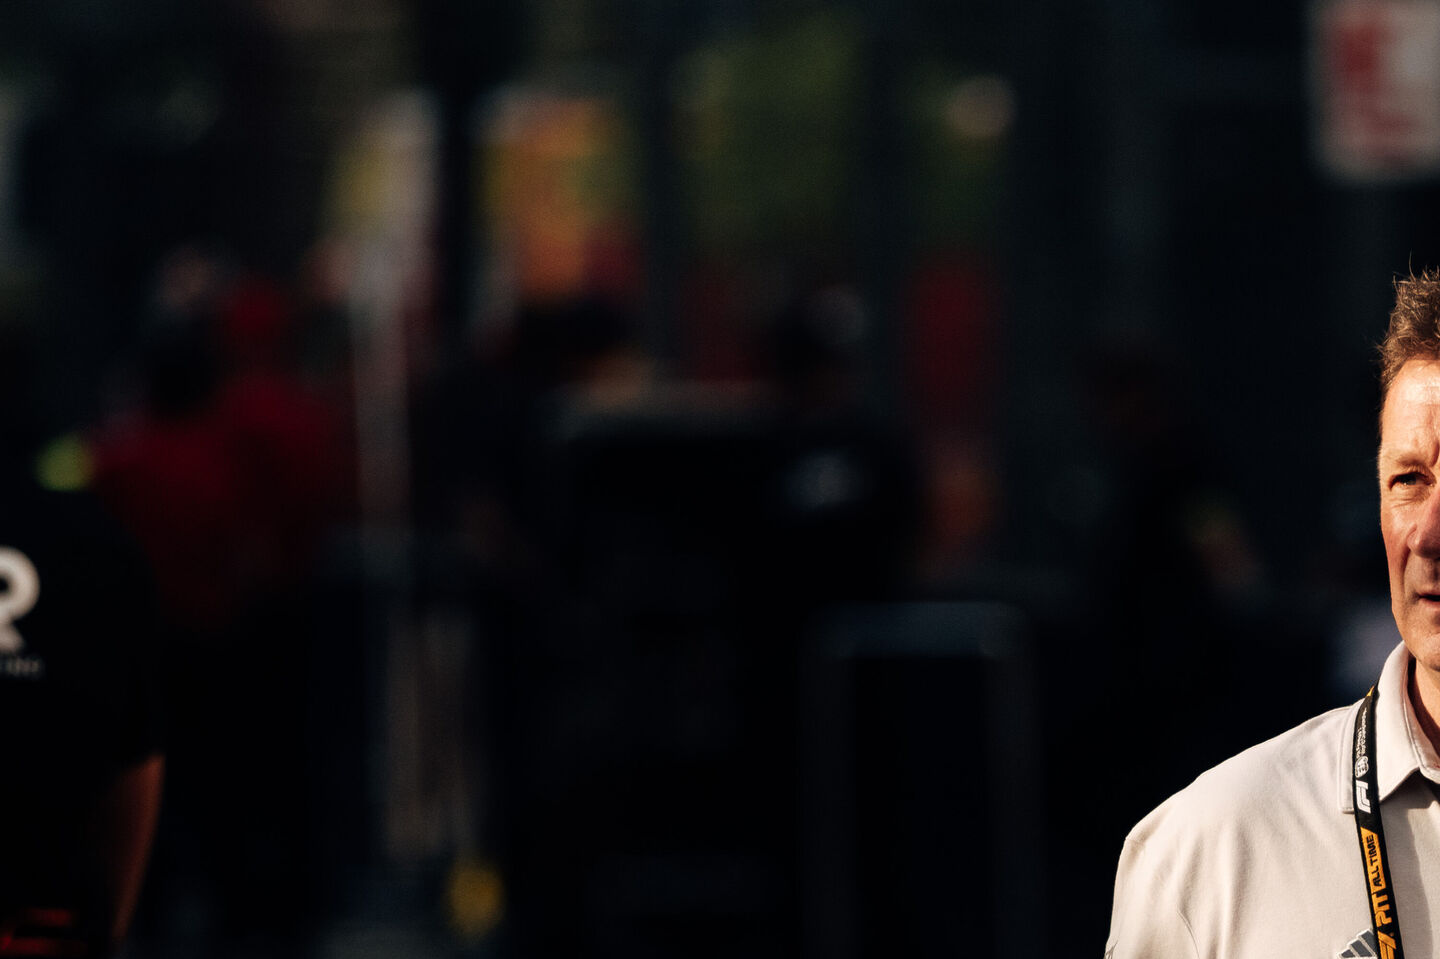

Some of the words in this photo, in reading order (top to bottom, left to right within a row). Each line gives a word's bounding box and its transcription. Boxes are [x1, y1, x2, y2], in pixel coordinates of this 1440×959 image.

[1366, 834, 1379, 866] TIME
[1369, 864, 1383, 887] ALL
[1371, 891, 1393, 928] PIT
